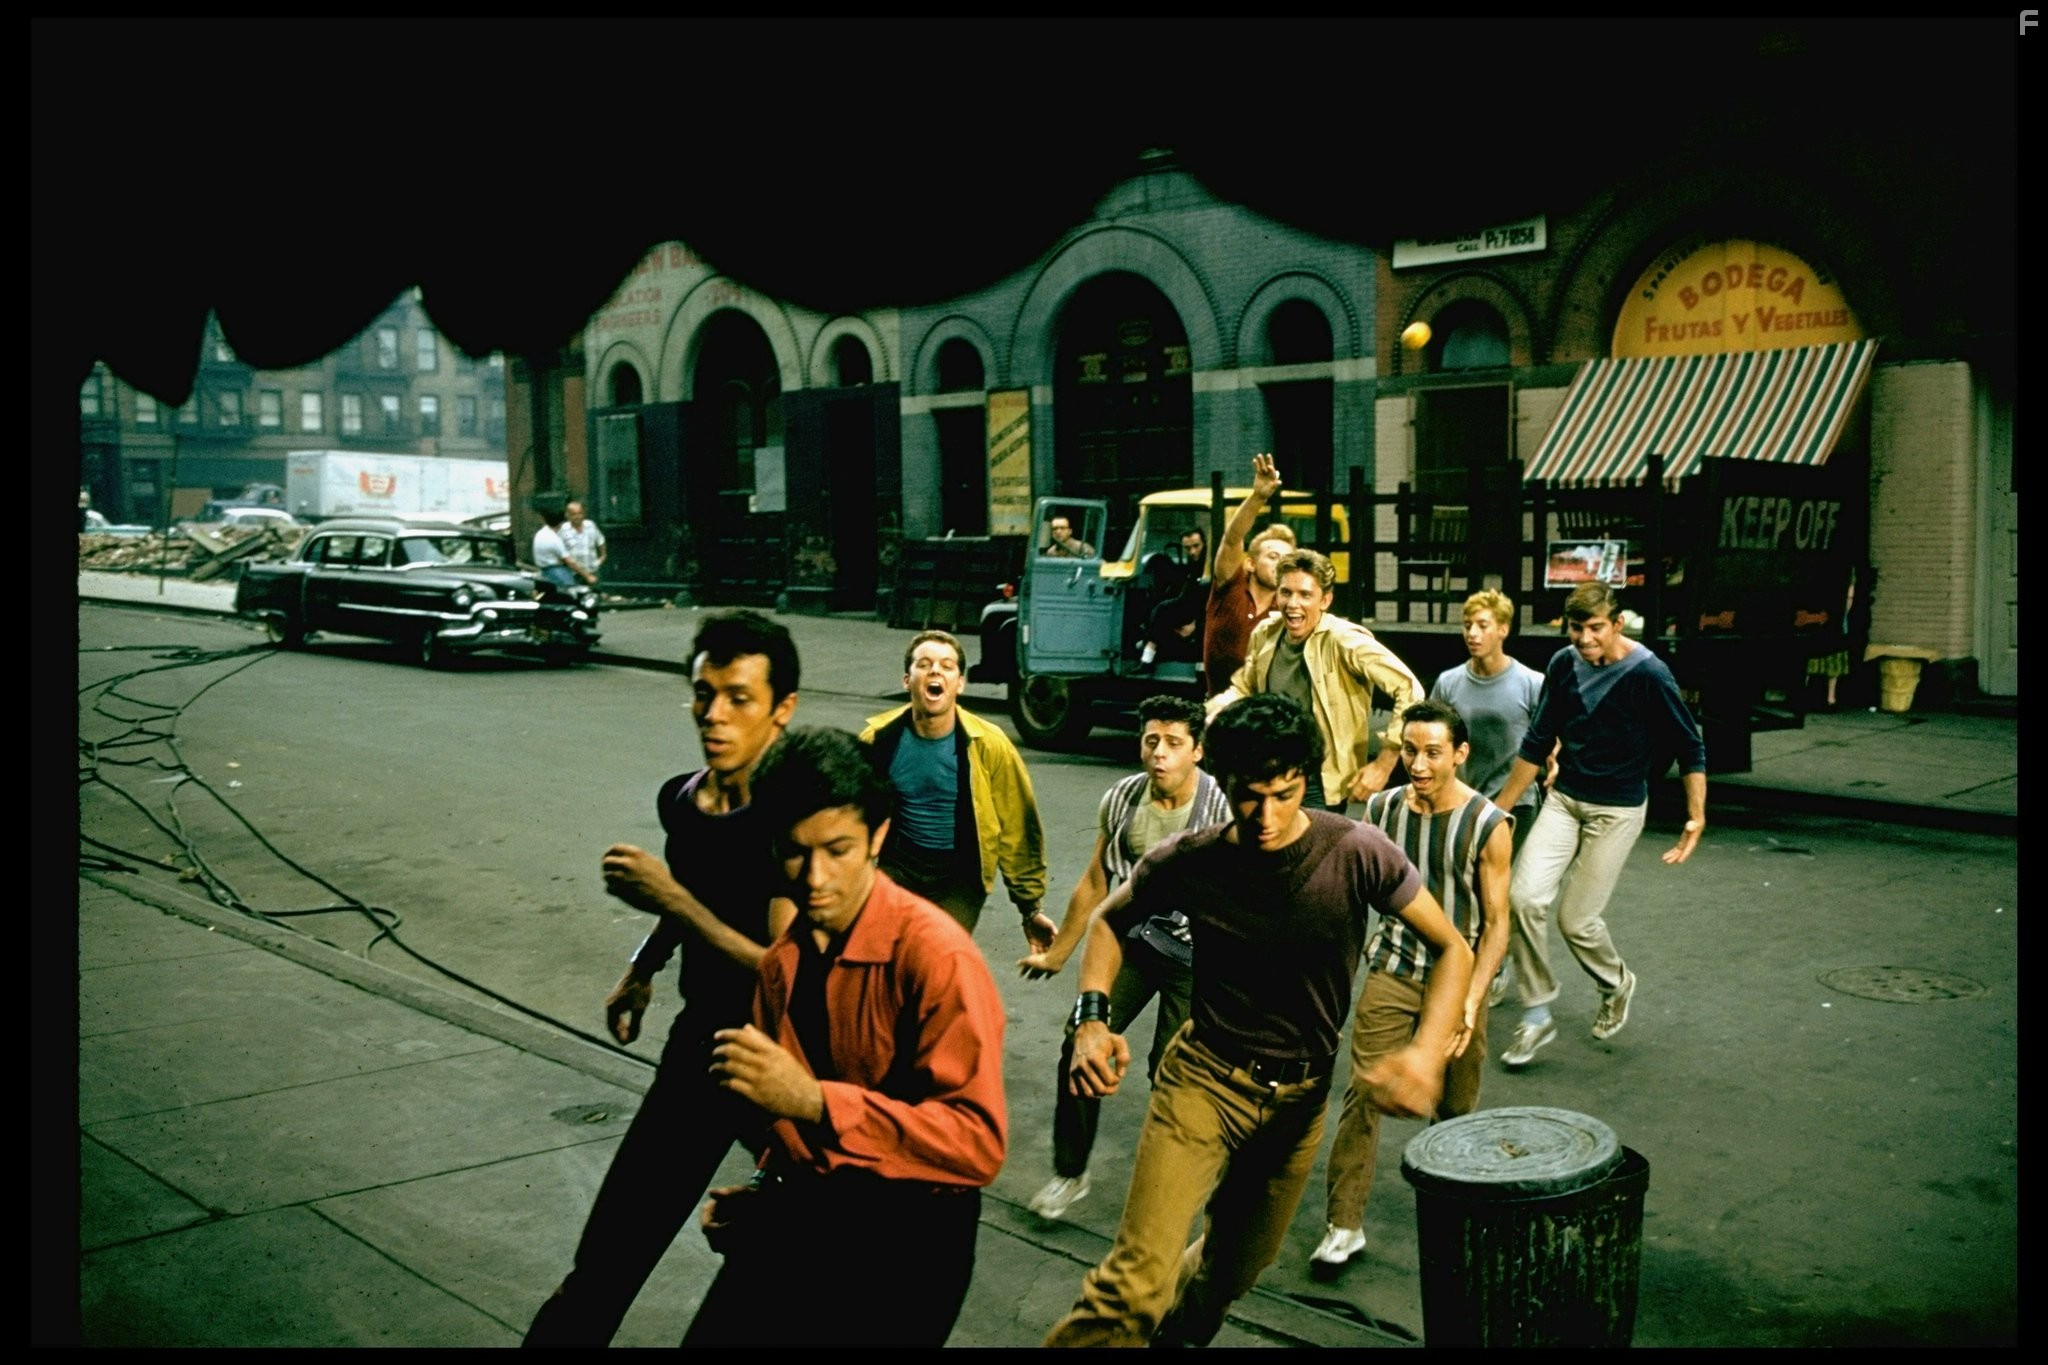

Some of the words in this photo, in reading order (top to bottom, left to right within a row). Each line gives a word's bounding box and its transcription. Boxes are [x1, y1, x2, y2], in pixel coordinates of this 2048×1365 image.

[1678, 263, 1806, 311] BODEGA
[1644, 316, 1722, 343] FRUTAS
[1732, 312, 1751, 334] Y
[1755, 306, 1850, 333] VEGETALES
[1717, 495, 1793, 550] KEEP
[1795, 499, 1841, 550] OFF
